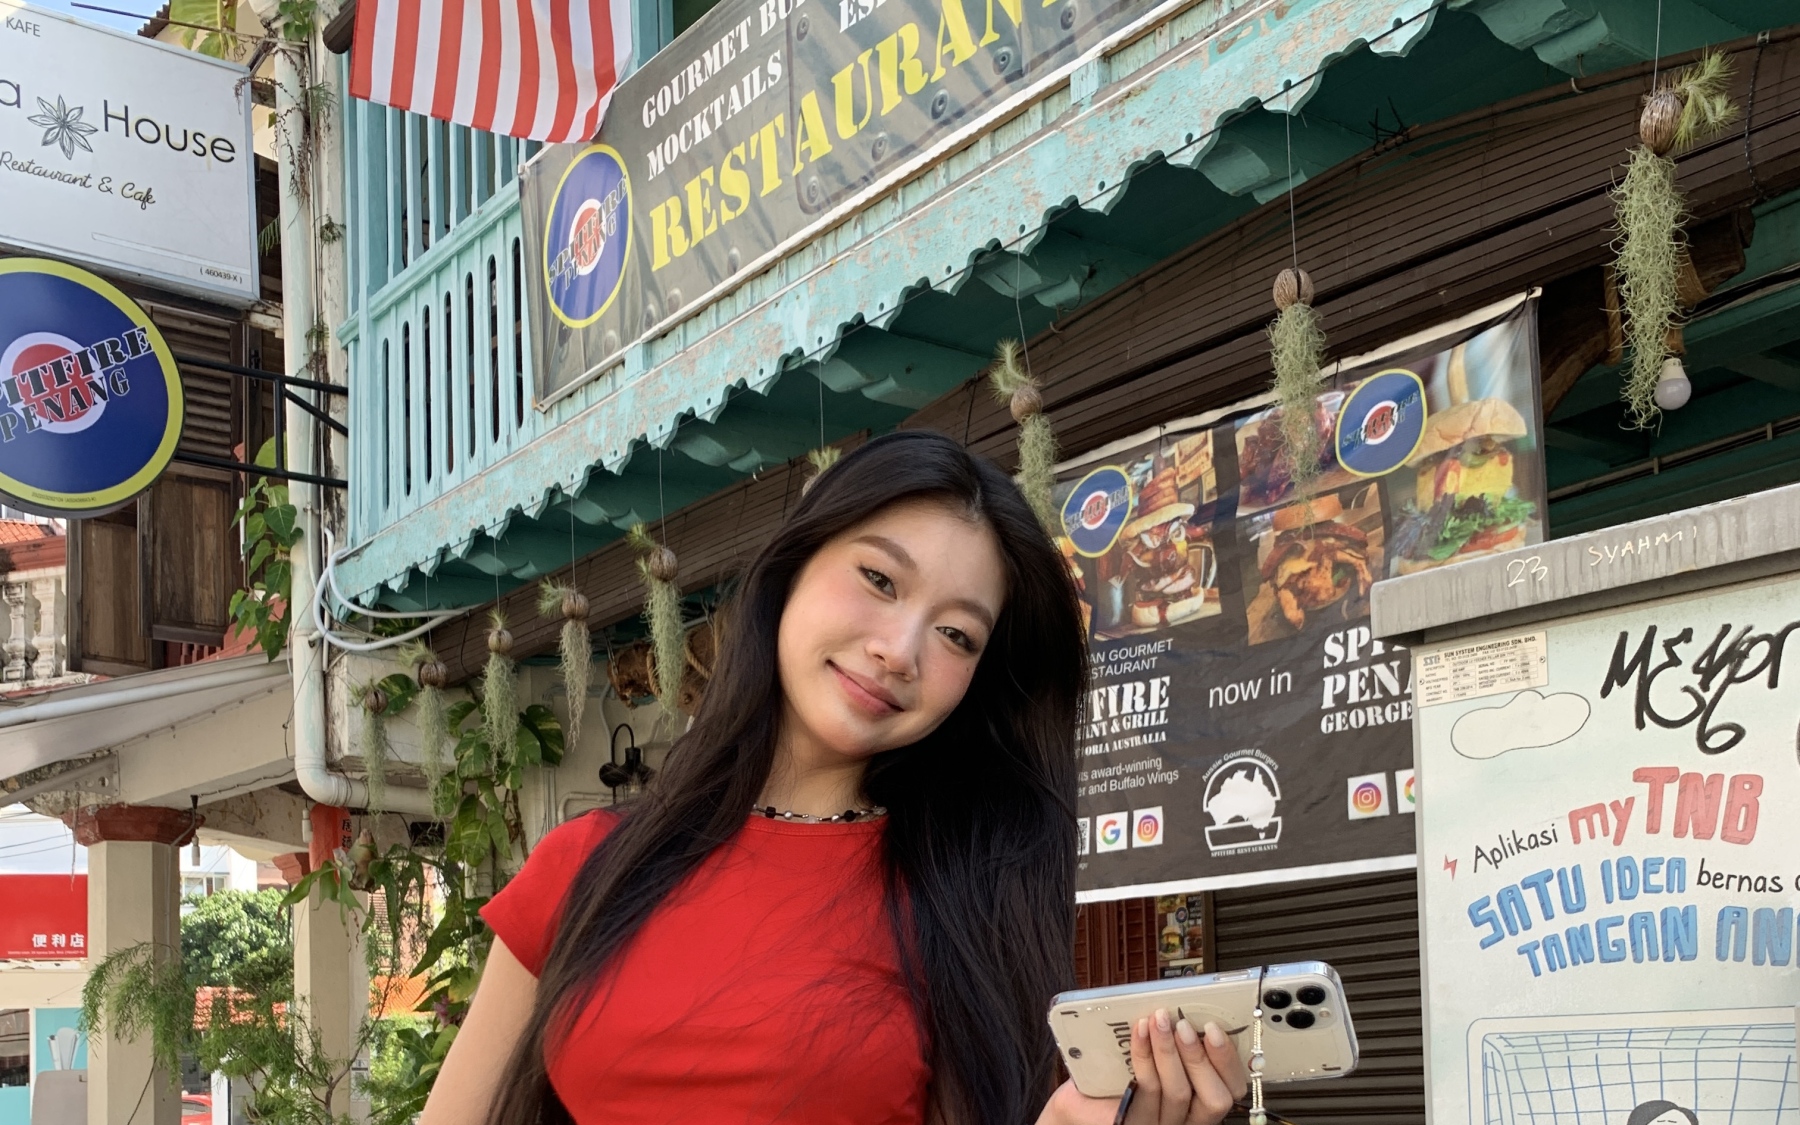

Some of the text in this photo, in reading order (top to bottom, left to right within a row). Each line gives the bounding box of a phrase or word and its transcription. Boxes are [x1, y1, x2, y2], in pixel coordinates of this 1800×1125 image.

[5, 16, 41, 38] KAFE
[839, 0, 886, 33] ES
[642, 0, 805, 128] GOURMET BU
[103, 99, 236, 163] House
[646, 50, 782, 181] MOCKTAILS
[648, 0, 1058, 272] RESTAURAN
[0, 151, 156, 210] Restaurant & Cafe
[549, 172, 629, 287] SPITFIRE
[565, 212, 617, 290] PENANG
[0, 326, 154, 407] ITFIRE
[0, 367, 130, 443] PENANG
[1506, 556, 1548, 588] 23
[1108, 639, 1174, 662] GOURMET
[1323, 626, 1408, 669] SP
[1455, 647, 1475, 656] SYSTEM
[1475, 641, 1510, 652] ENGINEERING
[1089, 676, 1170, 722] FIRE
[1209, 668, 1292, 708] now in
[1110, 718, 1120, 734] &
[1122, 709, 1169, 731] GRILL
[1112, 731, 1166, 752] AUSTRALIA
[1088, 781, 1107, 796] and
[1109, 774, 1145, 792] Buffalo
[1147, 769, 1179, 785] Wings
[1091, 756, 1162, 780] award-winning
[1202, 749, 1279, 782] Aussie Gourmet Burgers
[1473, 766, 1764, 873] Aplikasi myTNB
[1467, 856, 1784, 950] SATU IDEA bernas
[32, 932, 84, 948] 便利店
[1517, 905, 1800, 977] TANGAN AN
